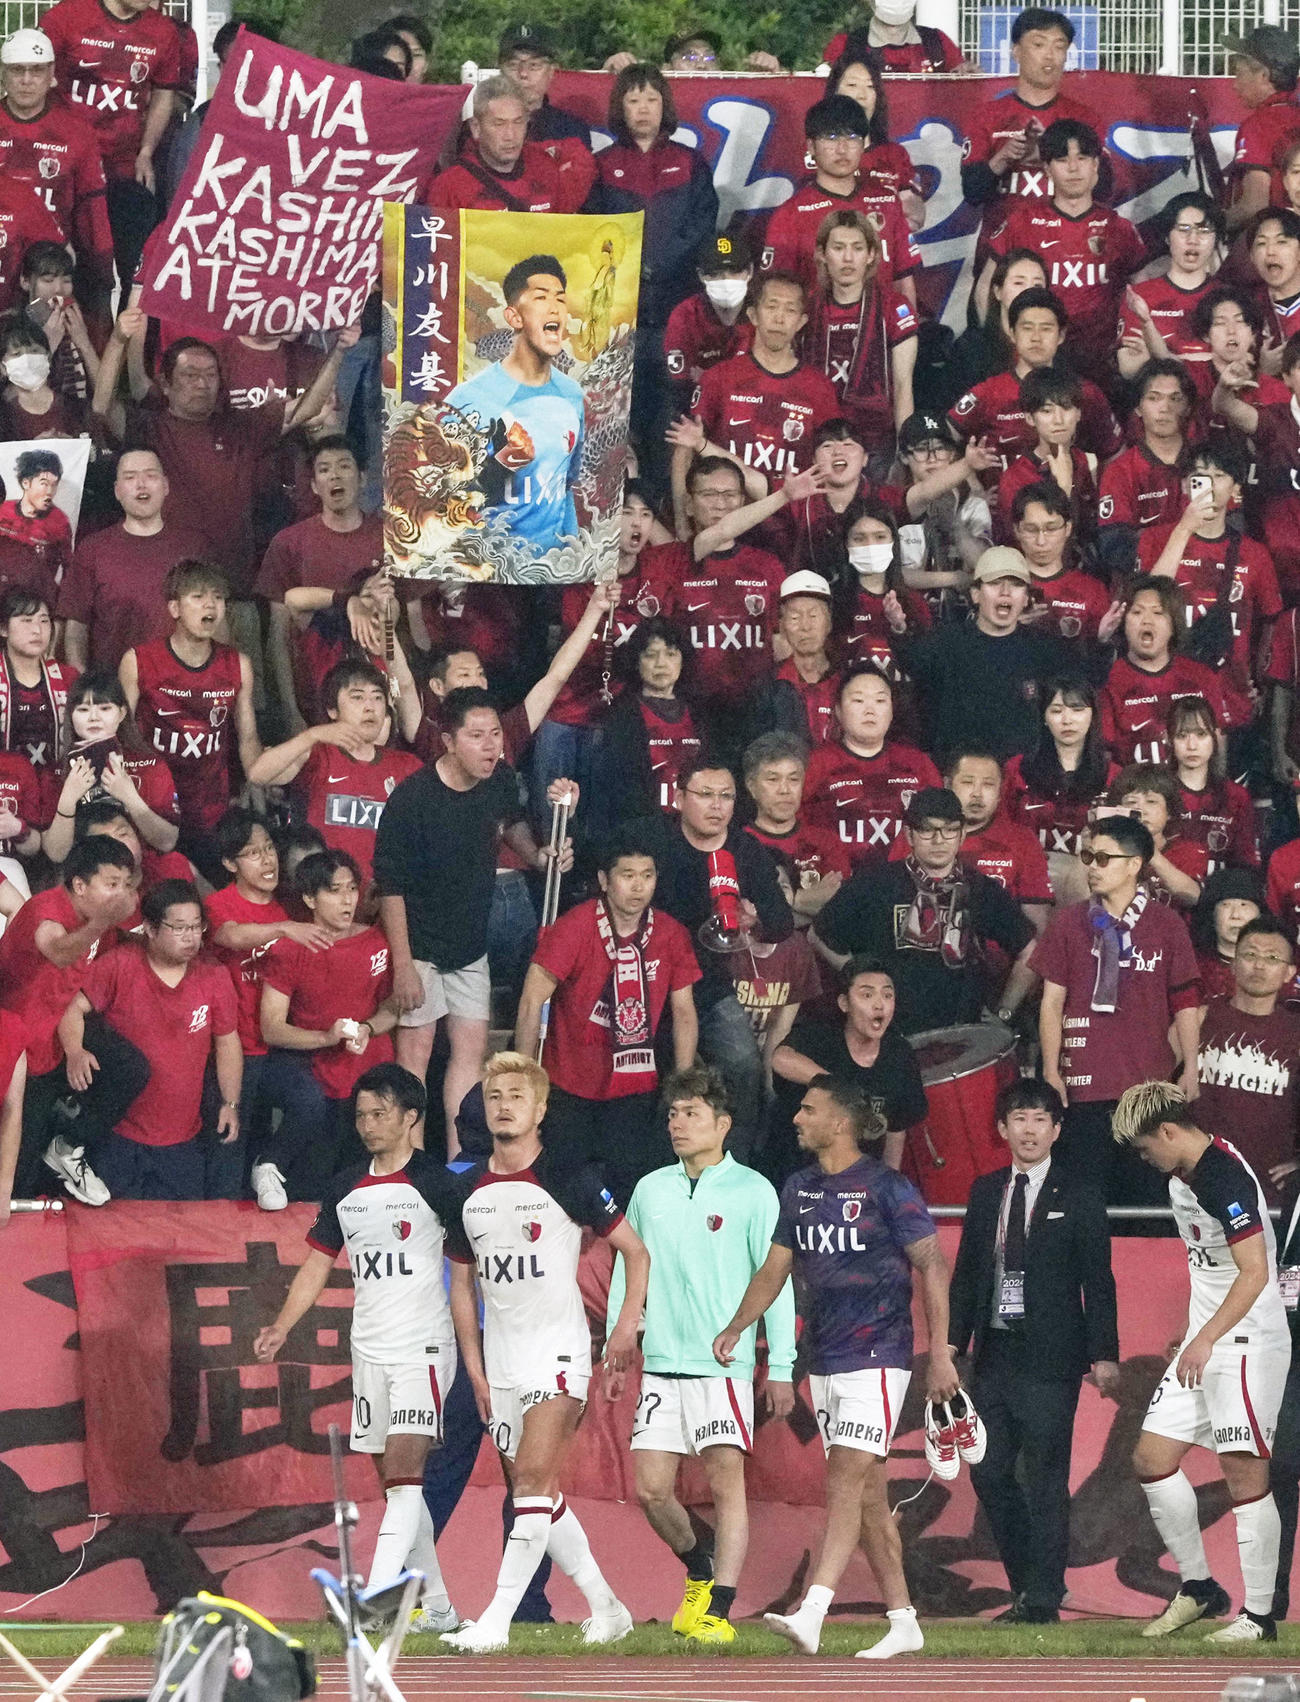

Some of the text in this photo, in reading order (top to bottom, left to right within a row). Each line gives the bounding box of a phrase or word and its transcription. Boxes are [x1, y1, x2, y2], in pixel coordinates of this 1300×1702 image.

[81, 37, 115, 49] mercari
[124, 43, 157, 56] mercari
[233, 49, 368, 144] UMA
[33, 141, 68, 153] mercari
[287, 134, 419, 196] VEZ
[168, 199, 379, 287] KASHIMA
[153, 243, 265, 313] ATE
[407, 215, 453, 392] 早川友基
[730, 394, 764, 403] mercari
[781, 401, 813, 414] mercari
[924, 416, 939, 429] LA
[1137, 488, 1169, 500] mercari
[683, 579, 718, 587] mercari
[735, 579, 768, 587] mercari
[1051, 599, 1086, 610] mercari
[690, 623, 764, 650] LIXIL
[203, 687, 235, 698] mercari
[1125, 695, 1158, 705] mercari
[830, 779, 863, 791] mercari
[332, 798, 383, 830] LIXI
[977, 858, 1013, 868] mercari
[797, 1190, 824, 1199] mercari
[837, 1191, 868, 1199] mercari
[340, 1204, 369, 1213] mercari
[385, 1201, 419, 1210] mercari
[465, 1205, 497, 1215] mercari
[515, 1200, 550, 1212] mercari
[352, 1250, 414, 1281] IXIL
